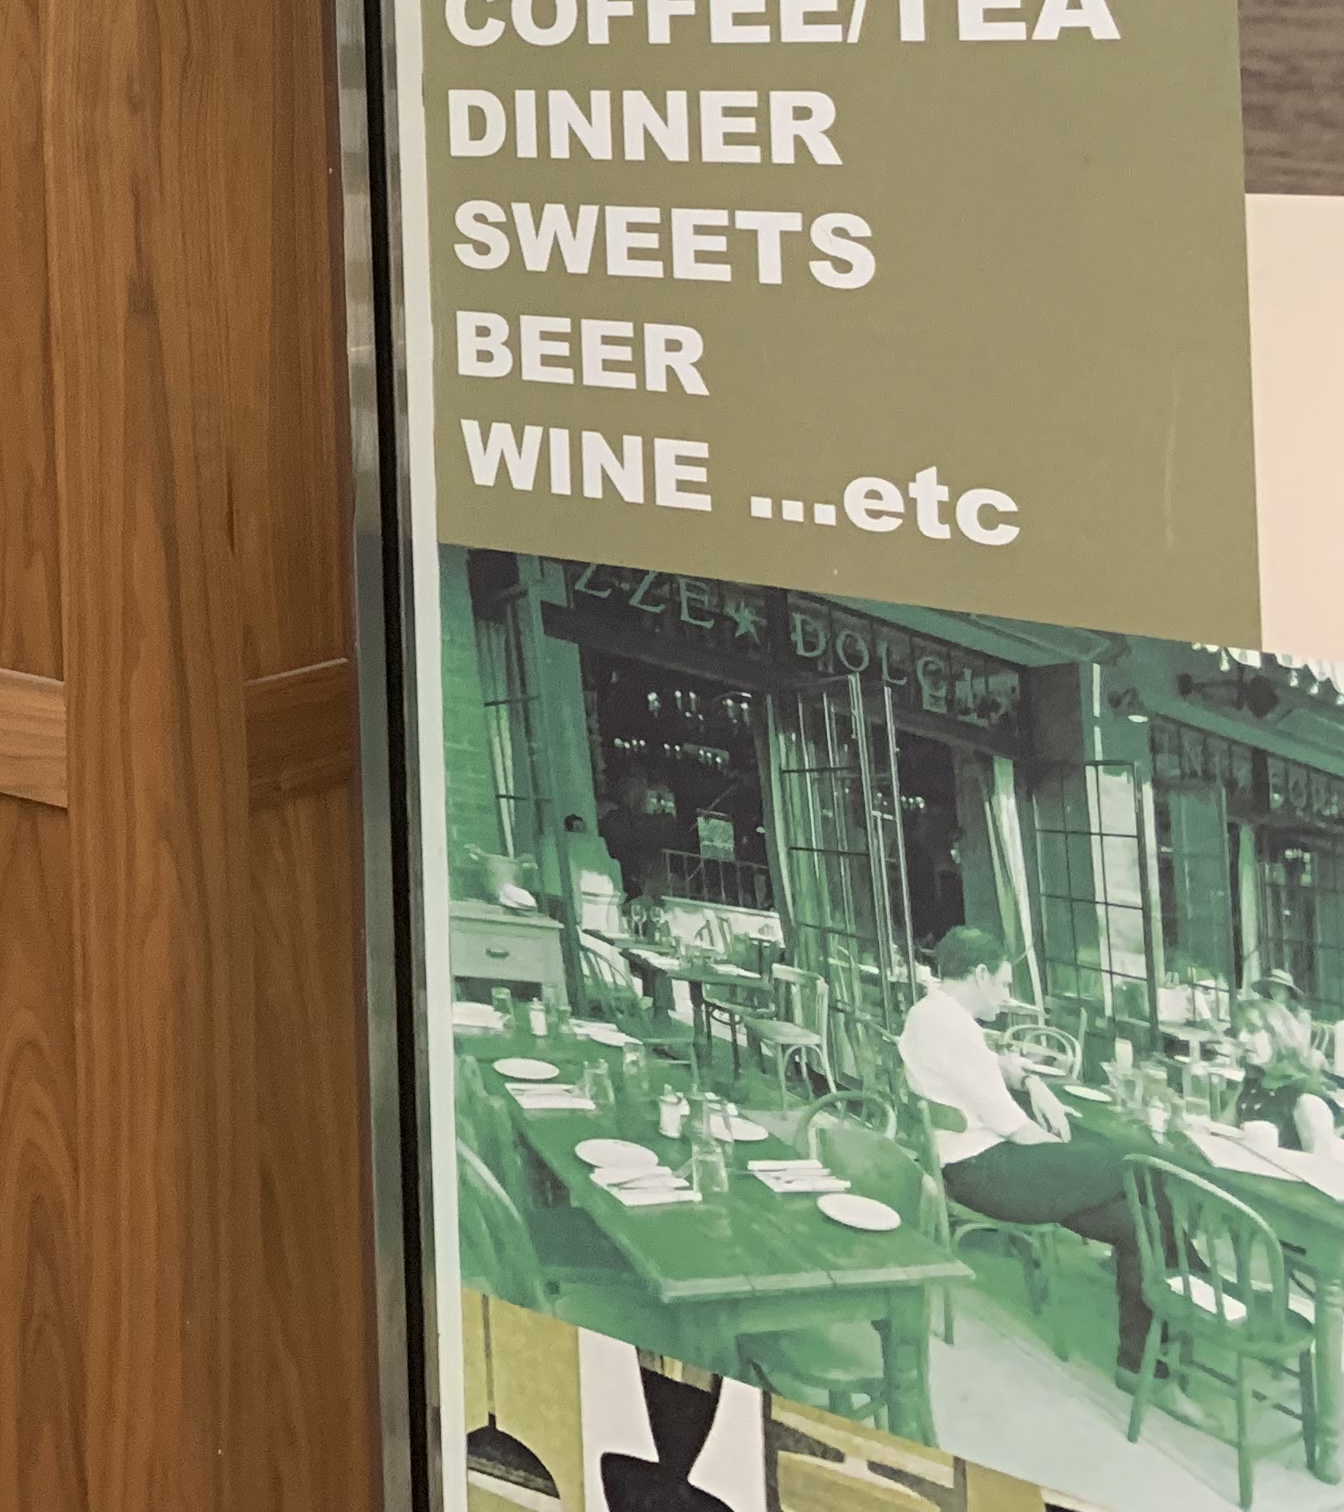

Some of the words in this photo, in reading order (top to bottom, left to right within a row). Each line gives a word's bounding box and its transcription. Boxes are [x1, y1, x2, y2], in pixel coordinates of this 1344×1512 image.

[448, 89, 844, 166] DINNER
[454, 200, 878, 290] SWEETS
[457, 311, 710, 396] BEER
[460, 419, 713, 512] WINE
